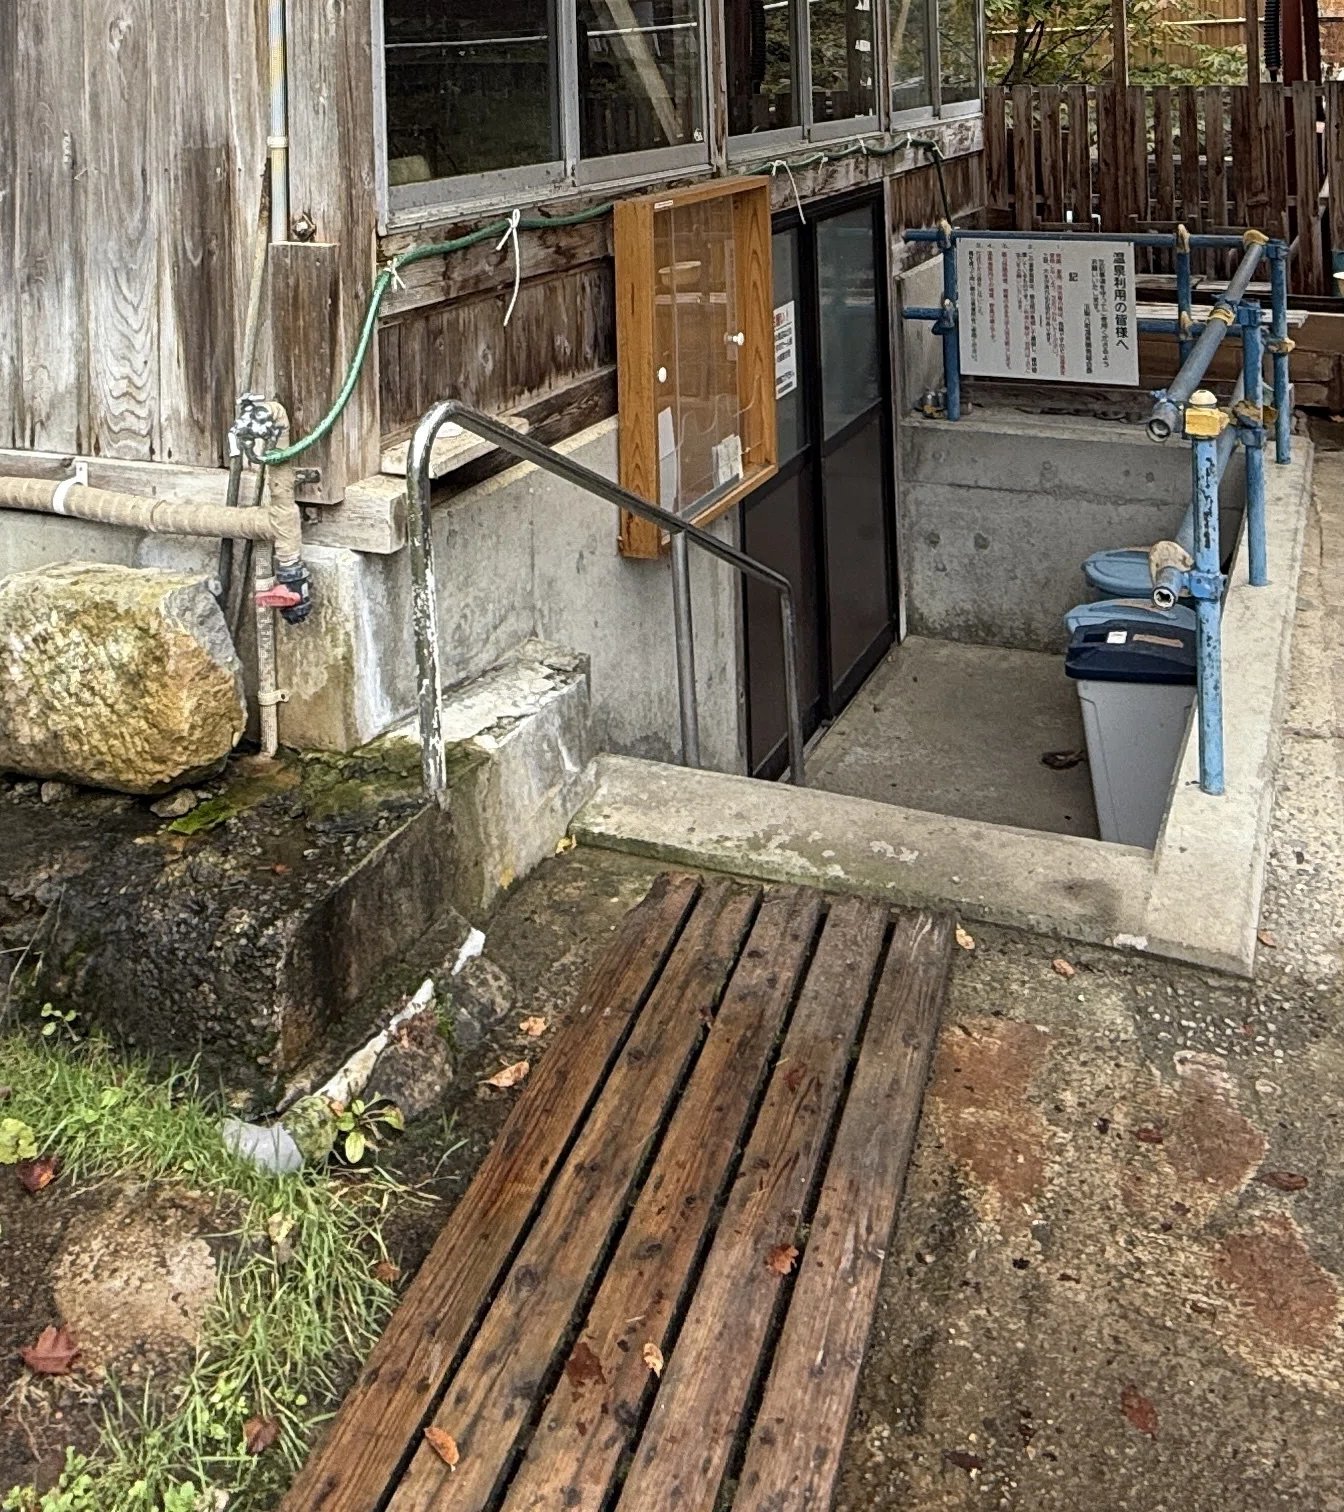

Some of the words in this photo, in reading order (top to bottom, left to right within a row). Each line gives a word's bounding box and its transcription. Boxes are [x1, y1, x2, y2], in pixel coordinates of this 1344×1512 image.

[1068, 272, 1078, 282] 記
[1113, 252, 1129, 350] 温泉利用の皆様へ
